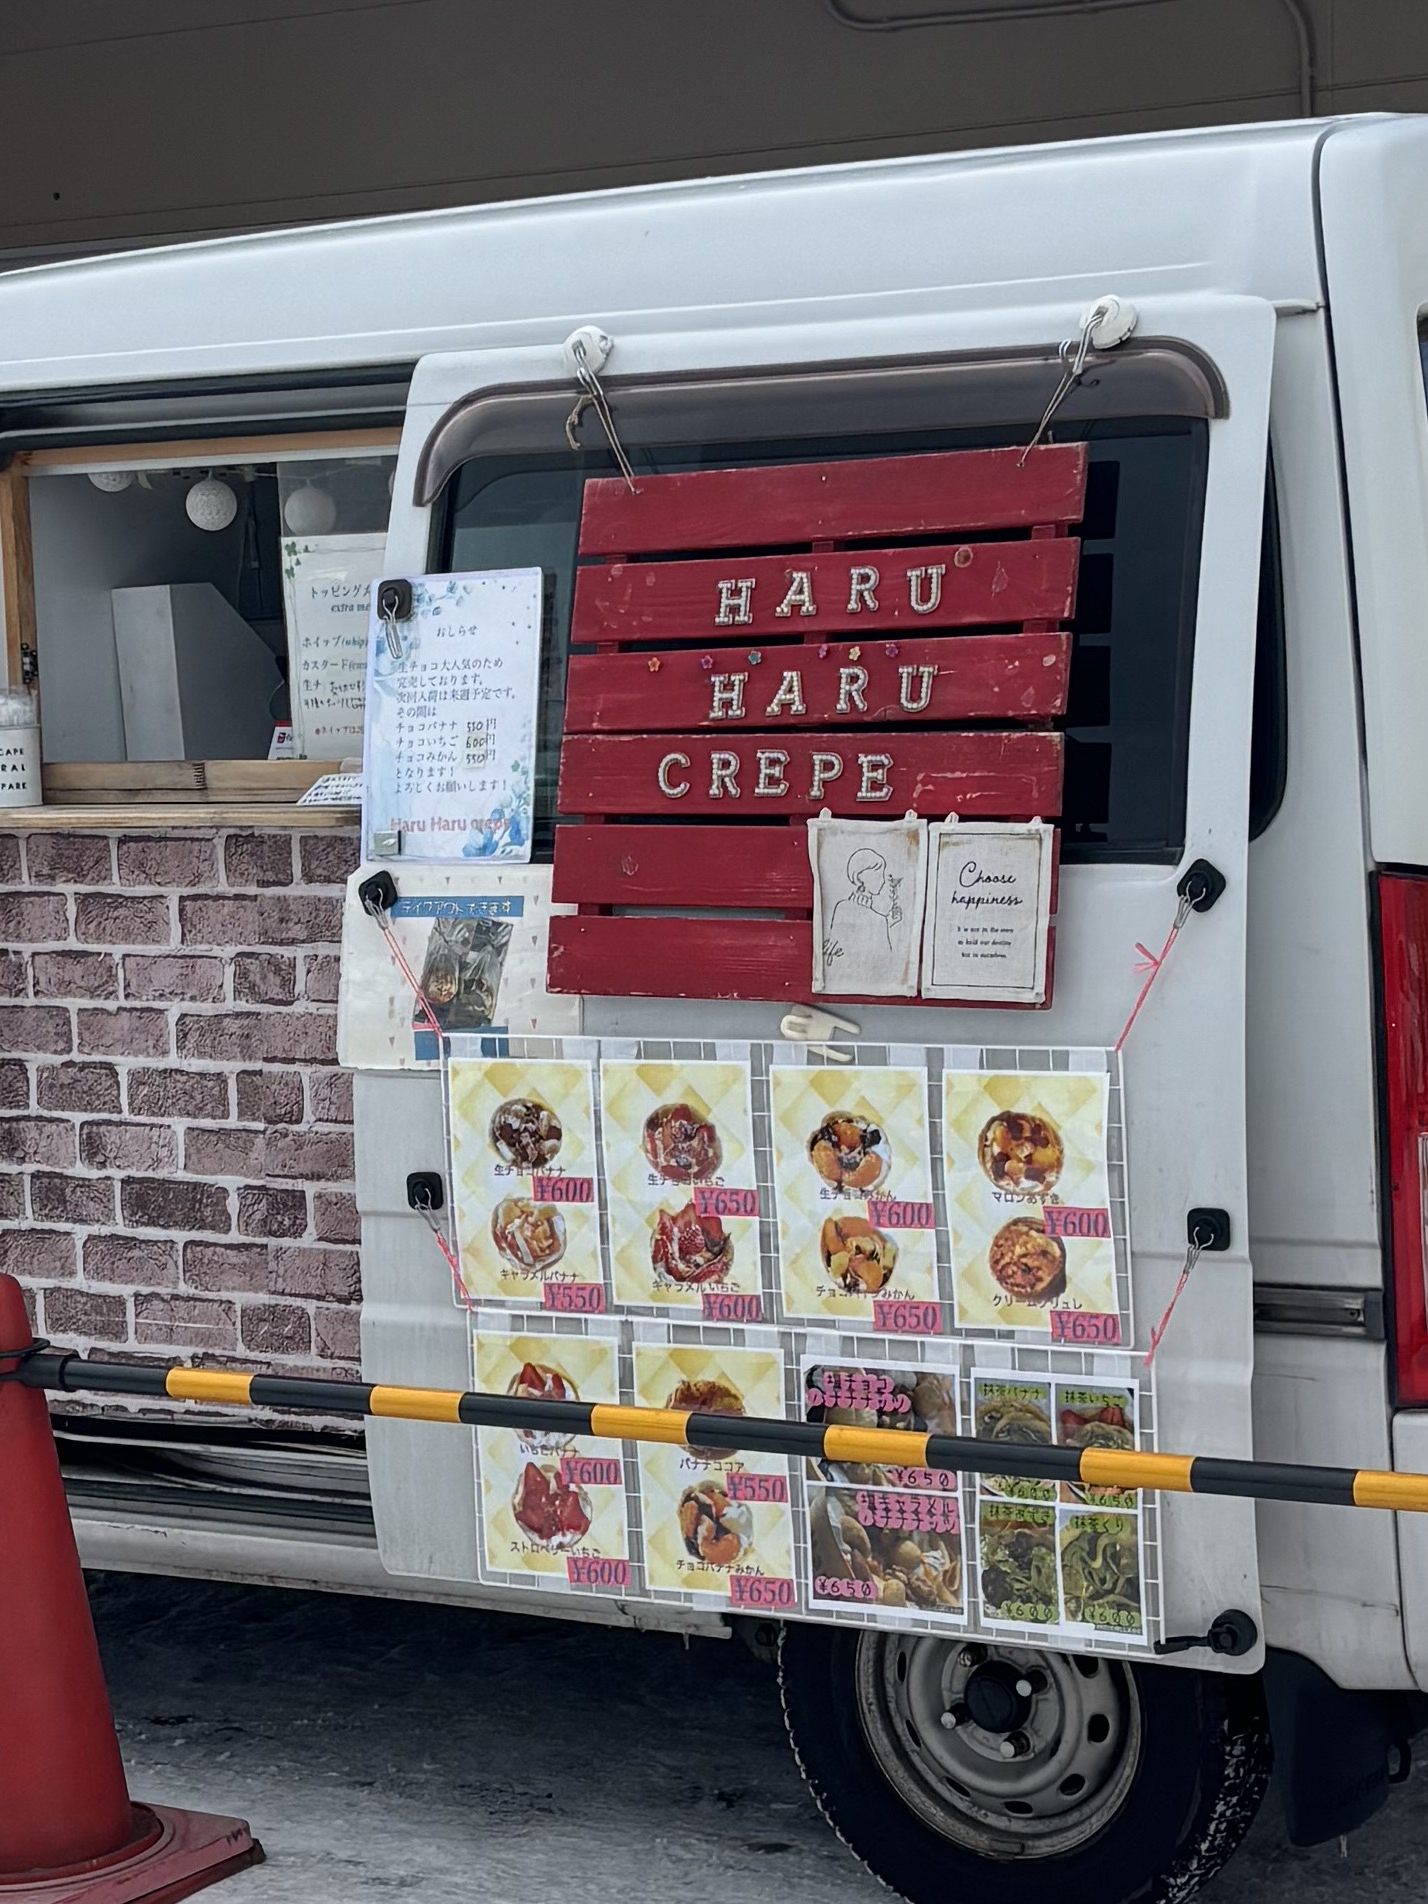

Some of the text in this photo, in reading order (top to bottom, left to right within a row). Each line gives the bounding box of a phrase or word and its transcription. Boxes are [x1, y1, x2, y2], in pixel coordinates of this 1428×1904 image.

[715, 563, 946, 626] HARU
[398, 657, 504, 673] 生チョコ大人気のため
[709, 663, 939, 722] HARU
[396, 721, 458, 733] チョコバナナ
[396, 735, 459, 748] チョコいちご
[395, 750, 458, 763] チョコみかん
[656, 749, 896, 802] CREPE
[390, 818, 426, 833] Haru
[430, 817, 467, 832] Haru
[959, 860, 1018, 888] Choose
[950, 891, 1024, 910] happiness
[535, 1180, 592, 1202] ¥600
[698, 1191, 757, 1214] ¥650
[871, 1203, 932, 1227] ¥600
[1045, 1209, 1109, 1236] ¥600
[546, 1286, 603, 1310] ¥550
[703, 1296, 761, 1320] ¥600
[876, 1304, 938, 1330] ¥650
[1056, 1315, 1118, 1341] ¥650
[562, 1459, 620, 1484] ¥600
[895, 1467, 950, 1487] ¥650
[728, 1475, 786, 1501] ¥550
[571, 1559, 628, 1584] ¥600
[734, 1579, 793, 1605] ¥650
[819, 1580, 872, 1597] ¥650
